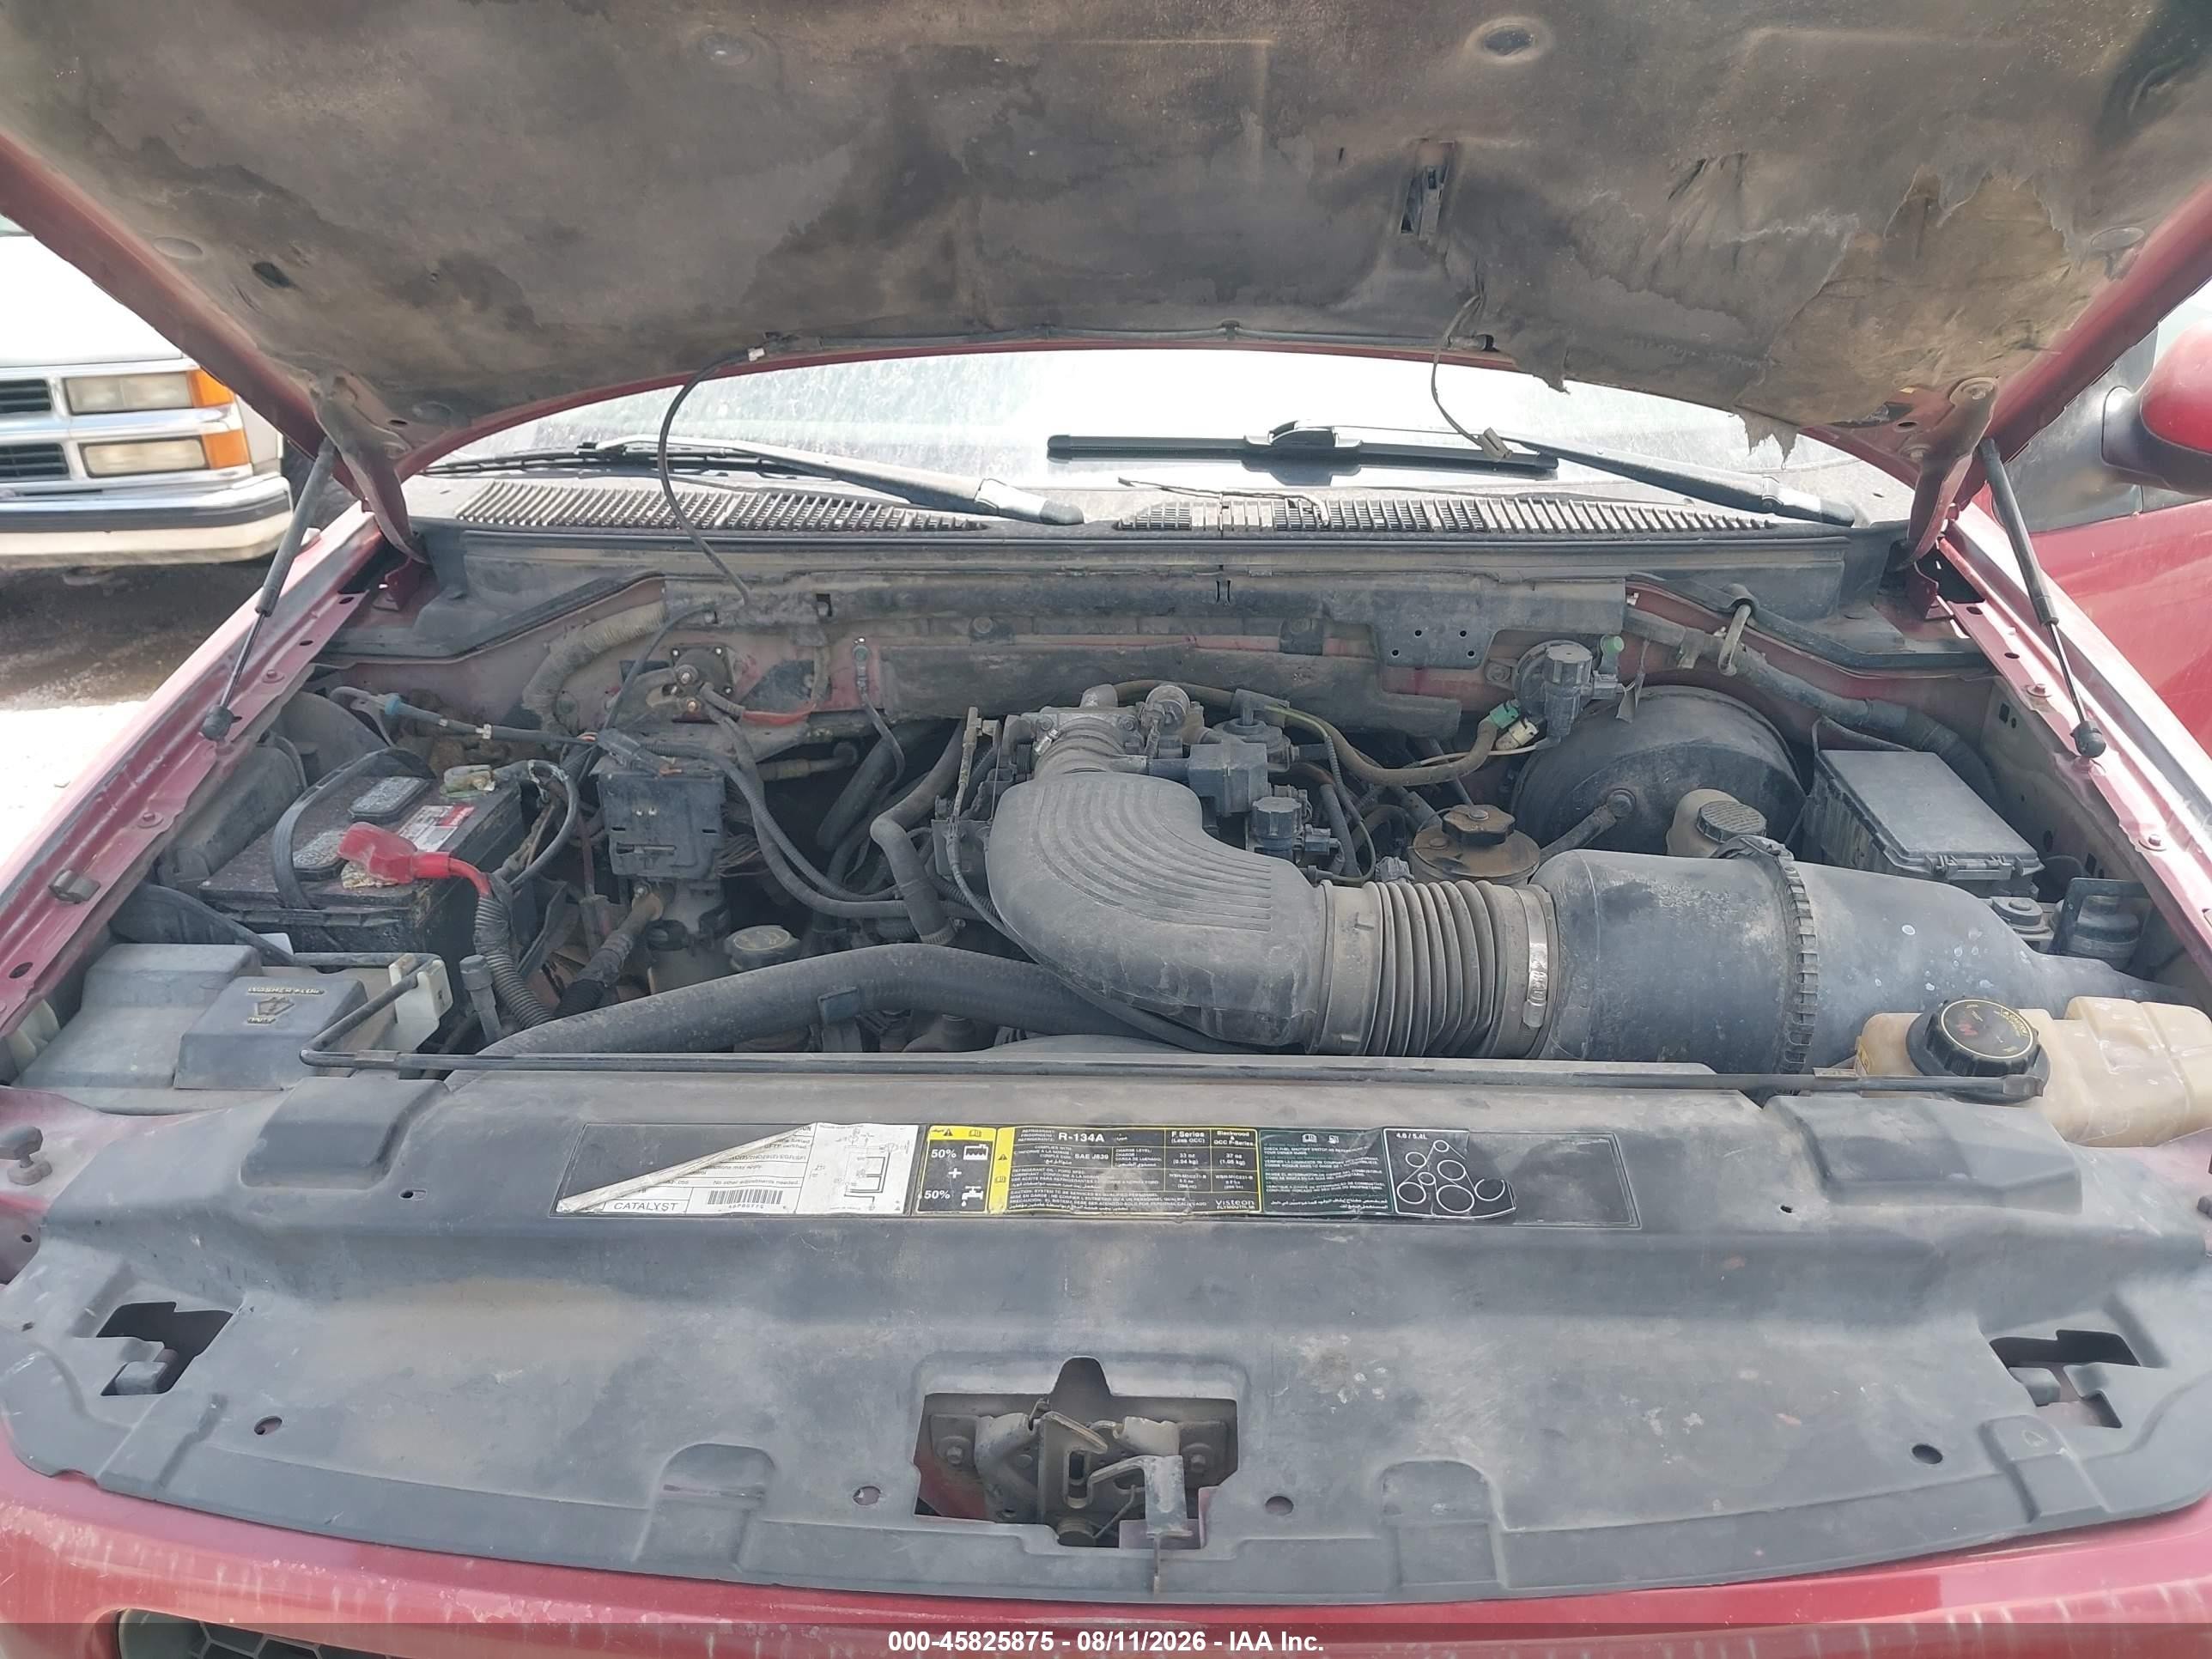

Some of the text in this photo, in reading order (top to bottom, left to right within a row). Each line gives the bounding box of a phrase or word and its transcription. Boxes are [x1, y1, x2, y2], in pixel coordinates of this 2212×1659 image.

[1058, 1133, 1105, 1143] R-134A
[931, 1149, 957, 1158] 50%
[924, 1190, 951, 1200] 50%
[614, 1201, 678, 1212] CATALYST
